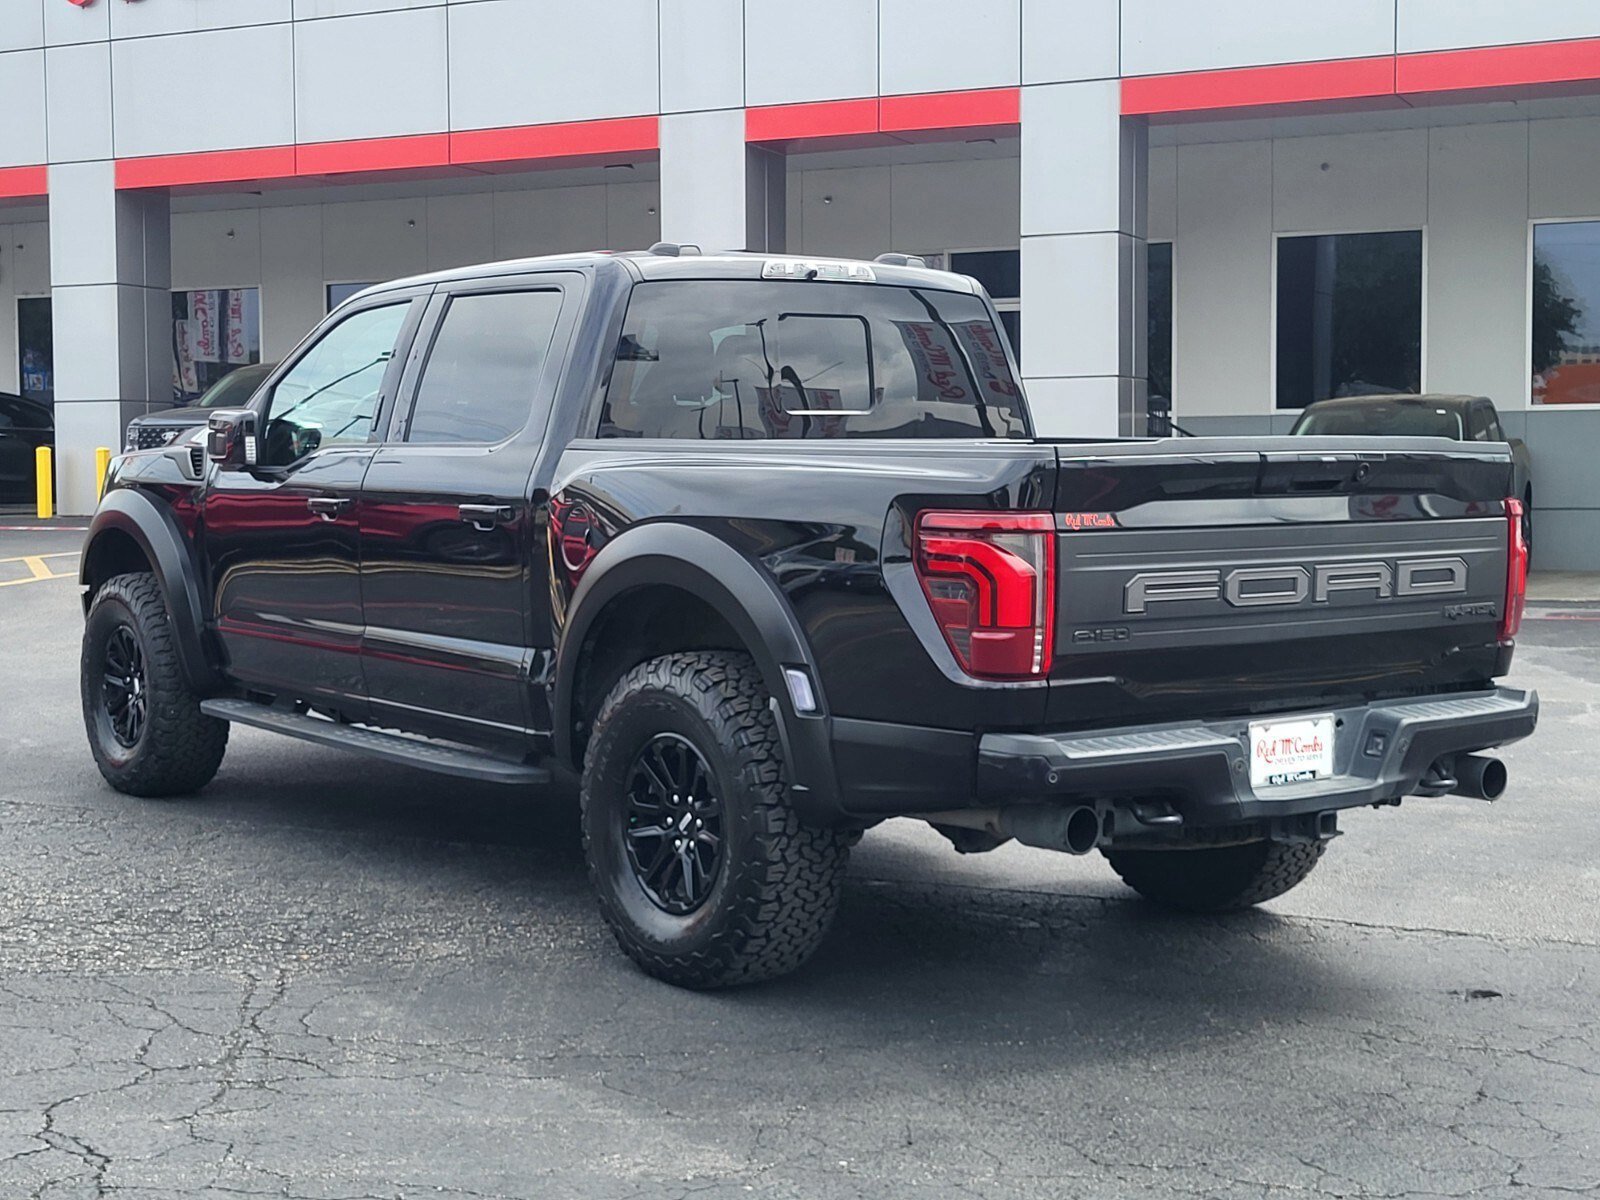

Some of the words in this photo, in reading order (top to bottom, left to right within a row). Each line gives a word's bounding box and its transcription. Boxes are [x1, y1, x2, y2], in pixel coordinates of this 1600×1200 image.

[1065, 512, 1081, 530] Red
[1124, 557, 1469, 614] FORD
[1257, 739, 1276, 763] Red
[1279, 735, 1322, 754] McCombs
